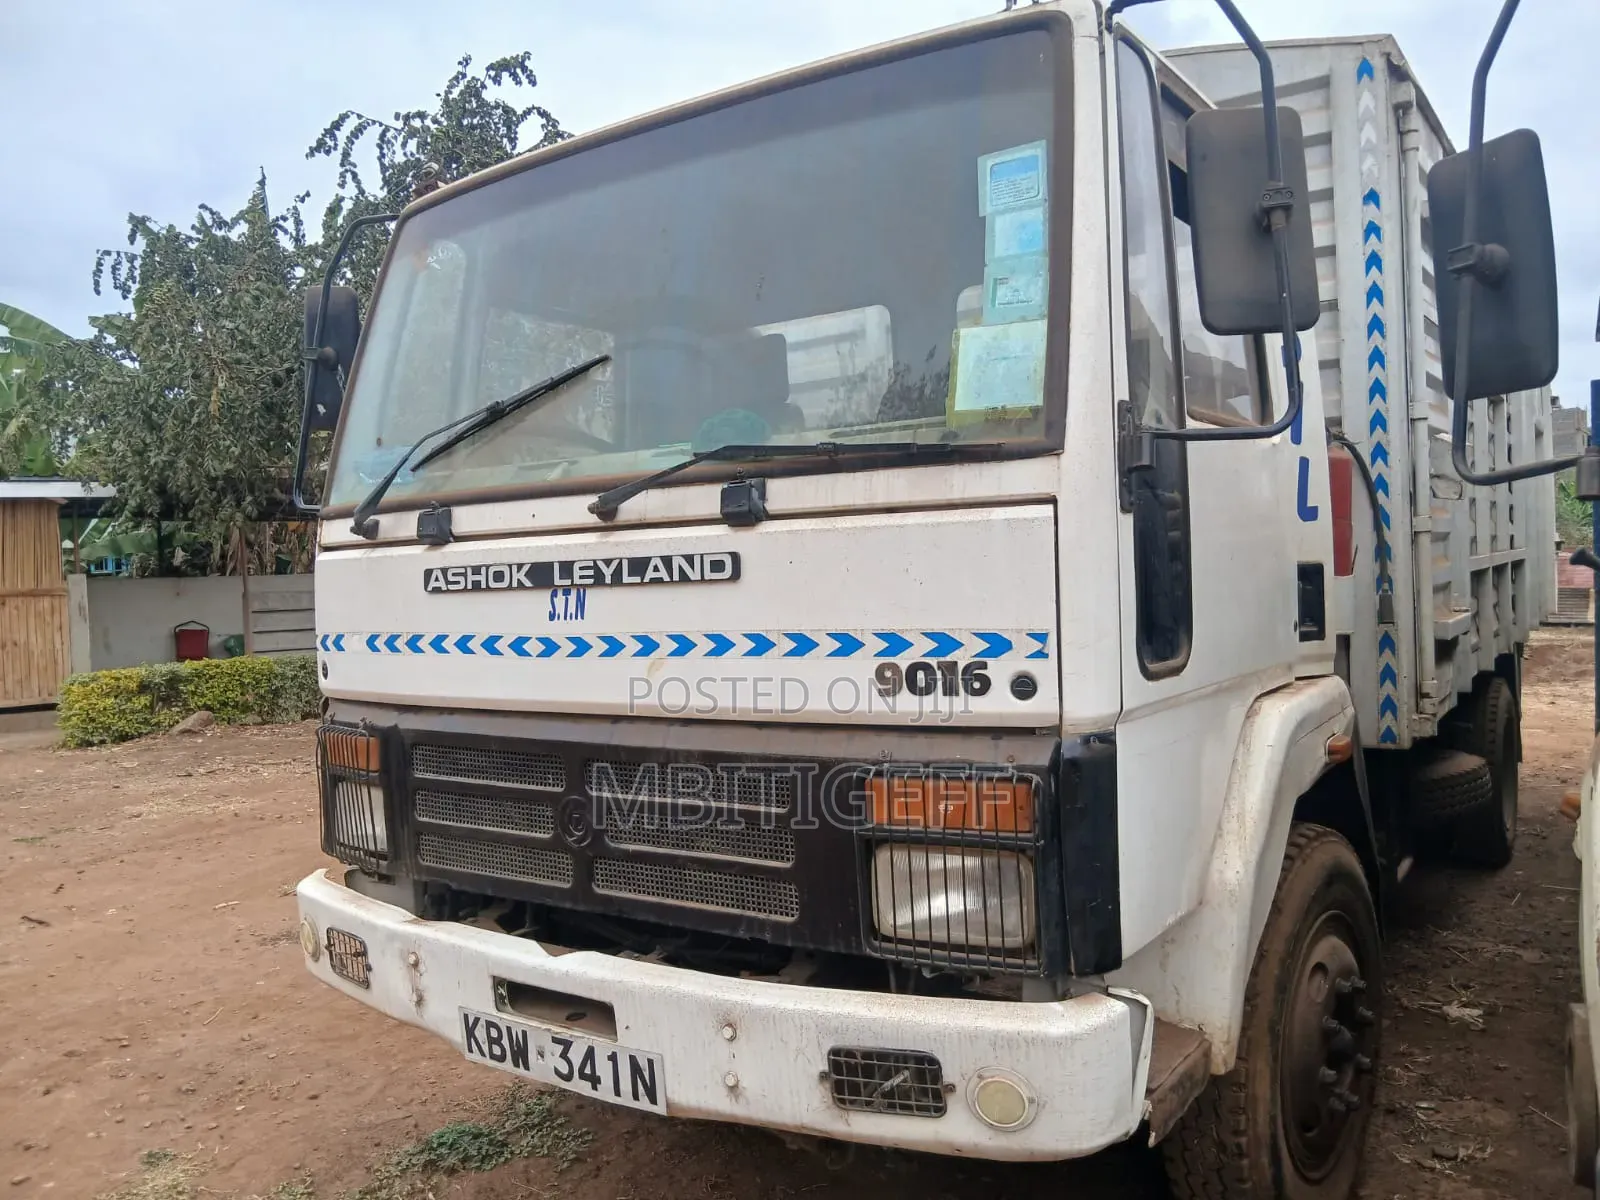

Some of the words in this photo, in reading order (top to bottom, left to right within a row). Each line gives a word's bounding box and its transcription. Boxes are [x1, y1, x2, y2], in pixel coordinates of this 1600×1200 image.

[426, 563, 533, 592] ASHOK
[553, 552, 734, 586] LEYLAND
[548, 587, 587, 622] S.T.N
[874, 660, 992, 698] 9016
[463, 1012, 531, 1072] KBW
[551, 1035, 659, 1106] 341N
